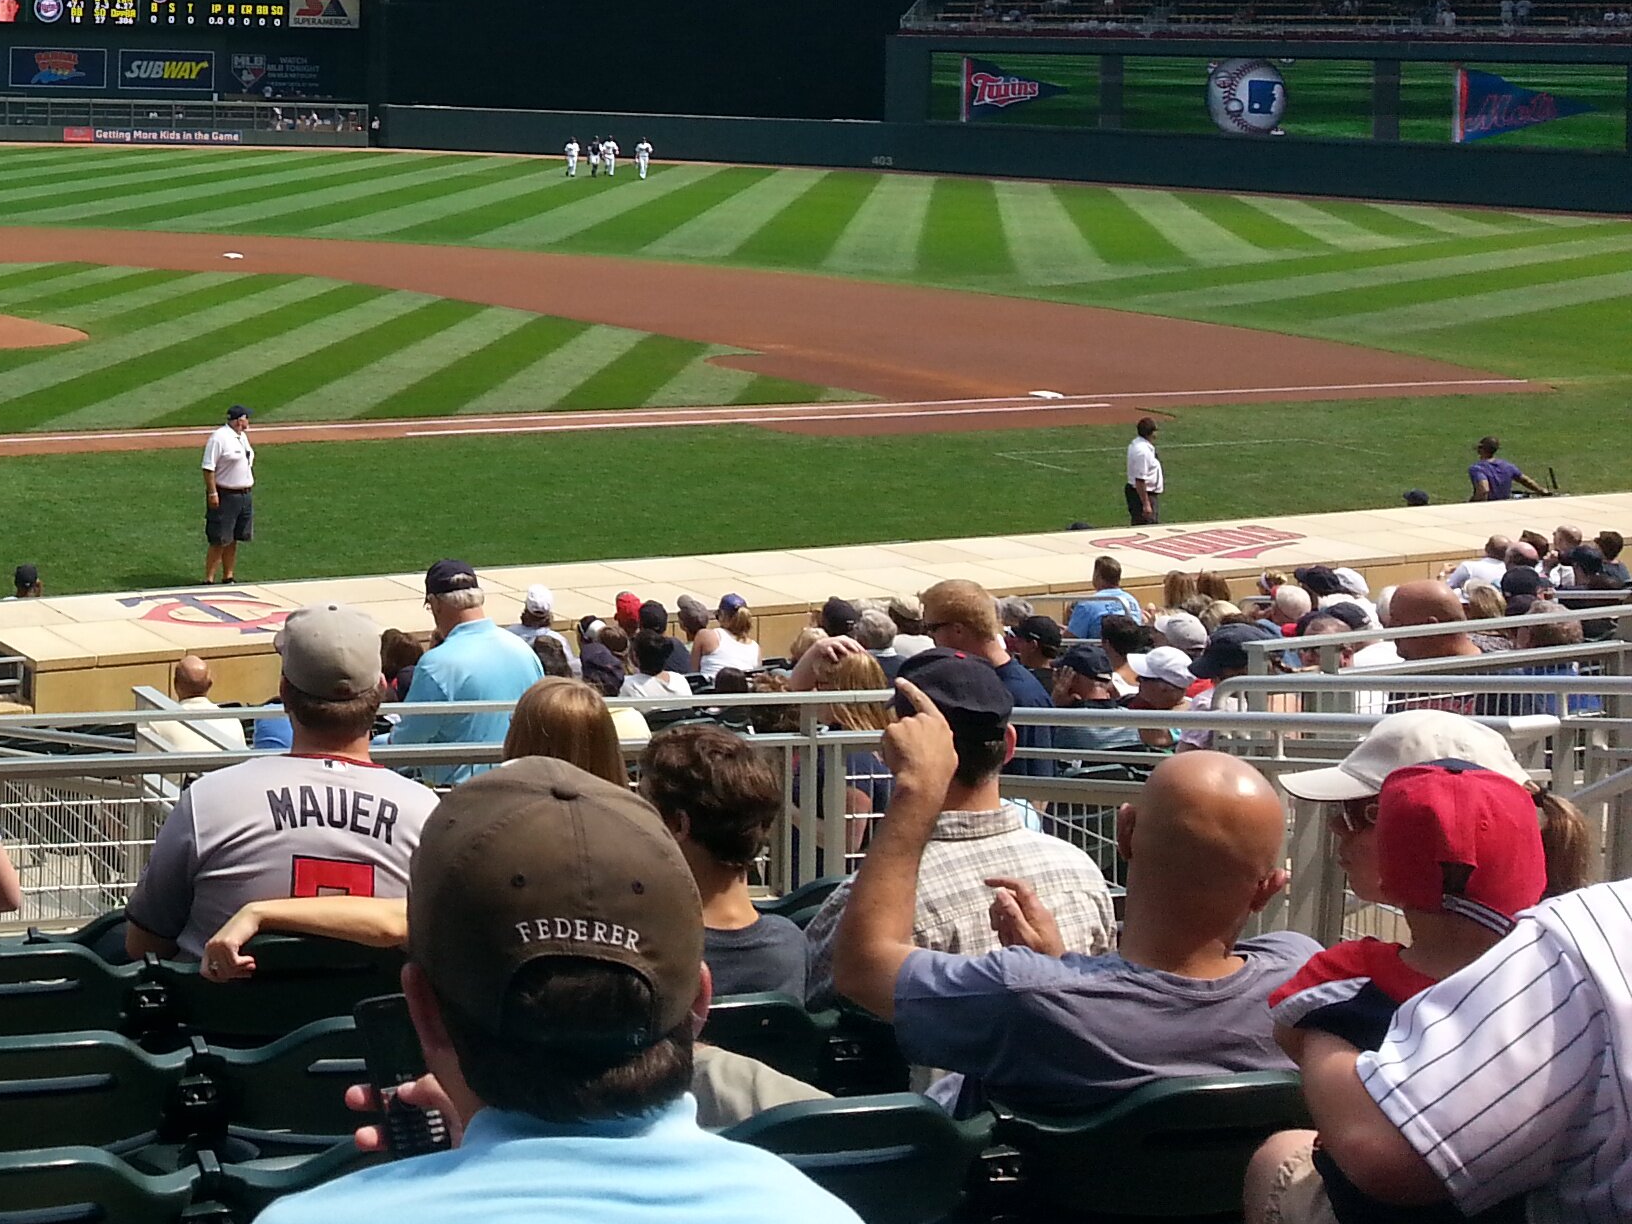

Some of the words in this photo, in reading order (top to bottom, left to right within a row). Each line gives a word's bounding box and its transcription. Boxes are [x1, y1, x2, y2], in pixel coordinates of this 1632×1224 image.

[125, 60, 209, 79] SUBWAY
[971, 72, 1039, 107] Twins
[95, 129, 131, 141] Getting
[133, 129, 158, 140] More
[159, 130, 181, 140] Kids
[194, 130, 210, 140] the
[211, 131, 240, 141] Game
[871, 156, 893, 166] 403
[1089, 525, 1307, 561] Twins
[266, 785, 399, 846] MAUER
[515, 917, 640, 954] FEDERER
